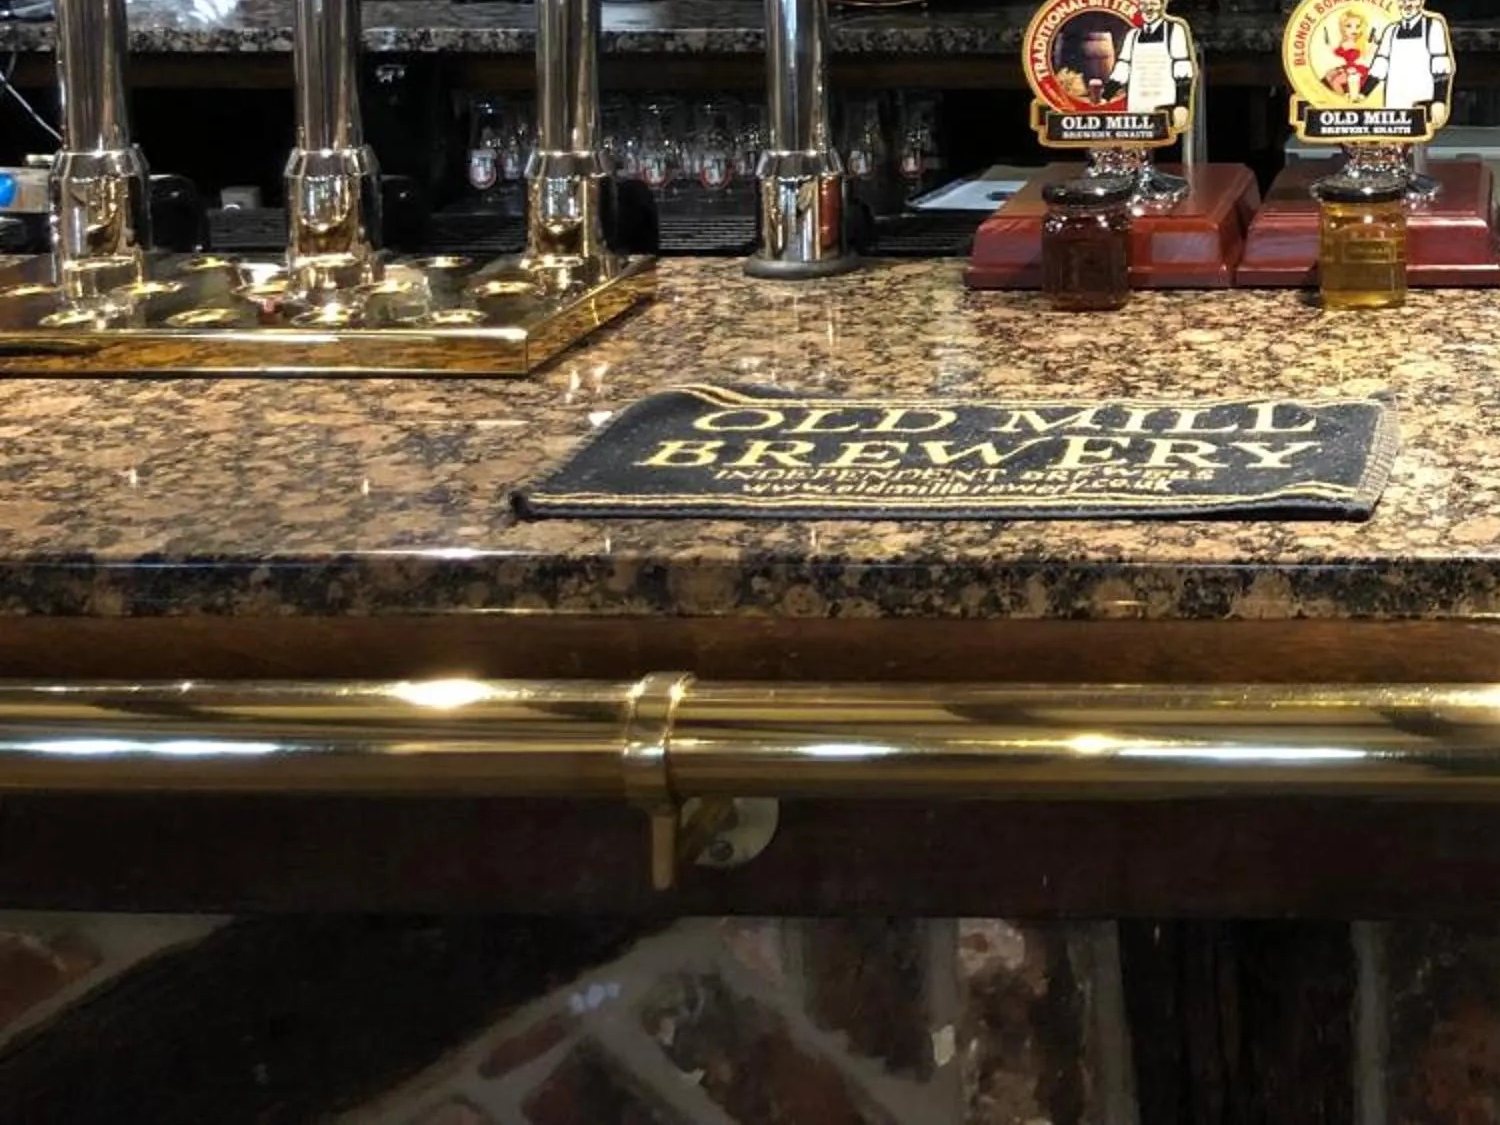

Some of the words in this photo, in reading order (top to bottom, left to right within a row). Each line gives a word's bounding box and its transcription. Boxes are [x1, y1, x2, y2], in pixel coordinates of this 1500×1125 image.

[1294, 13, 1316, 67] BLONDE
[1060, 115, 1101, 130] OLD
[1105, 115, 1155, 130] MILL
[1319, 110, 1360, 125] OLD
[1363, 110, 1413, 125] MILL
[693, 407, 959, 434] OLD
[988, 402, 1318, 434] MILL
[631, 435, 1323, 470] BREWERY
[711, 466, 1008, 482] INDEPENDENT
[742, 474, 1173, 496] www.oldmillbrewery.co.uk
